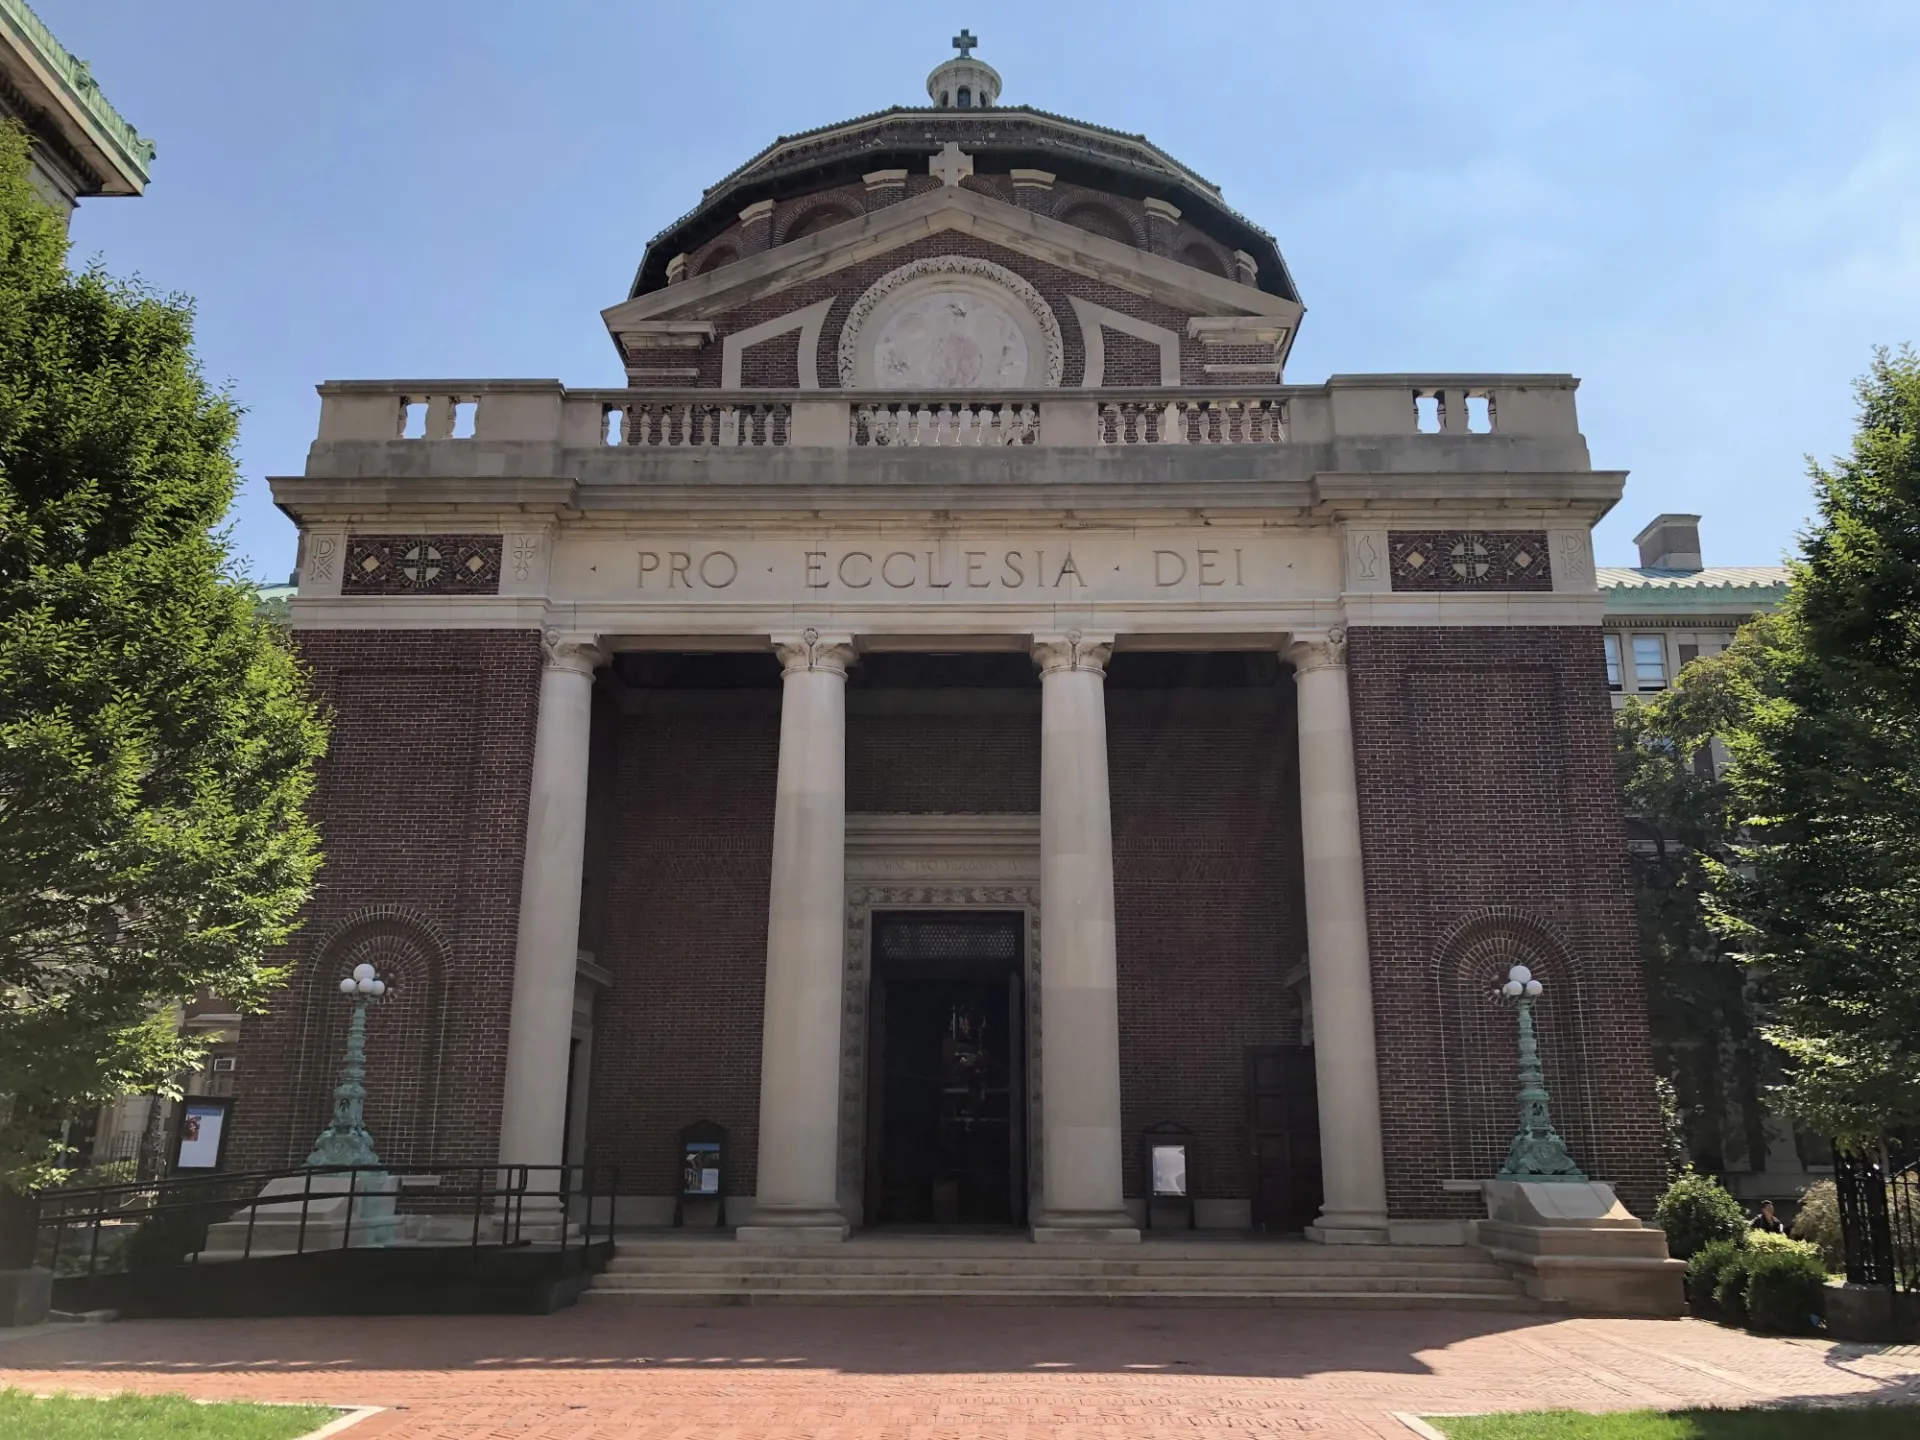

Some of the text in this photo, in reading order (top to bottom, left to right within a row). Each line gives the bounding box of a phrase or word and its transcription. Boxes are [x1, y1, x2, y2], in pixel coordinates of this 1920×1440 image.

[637, 548, 1244, 589] PRO ECCLESIA DEI
